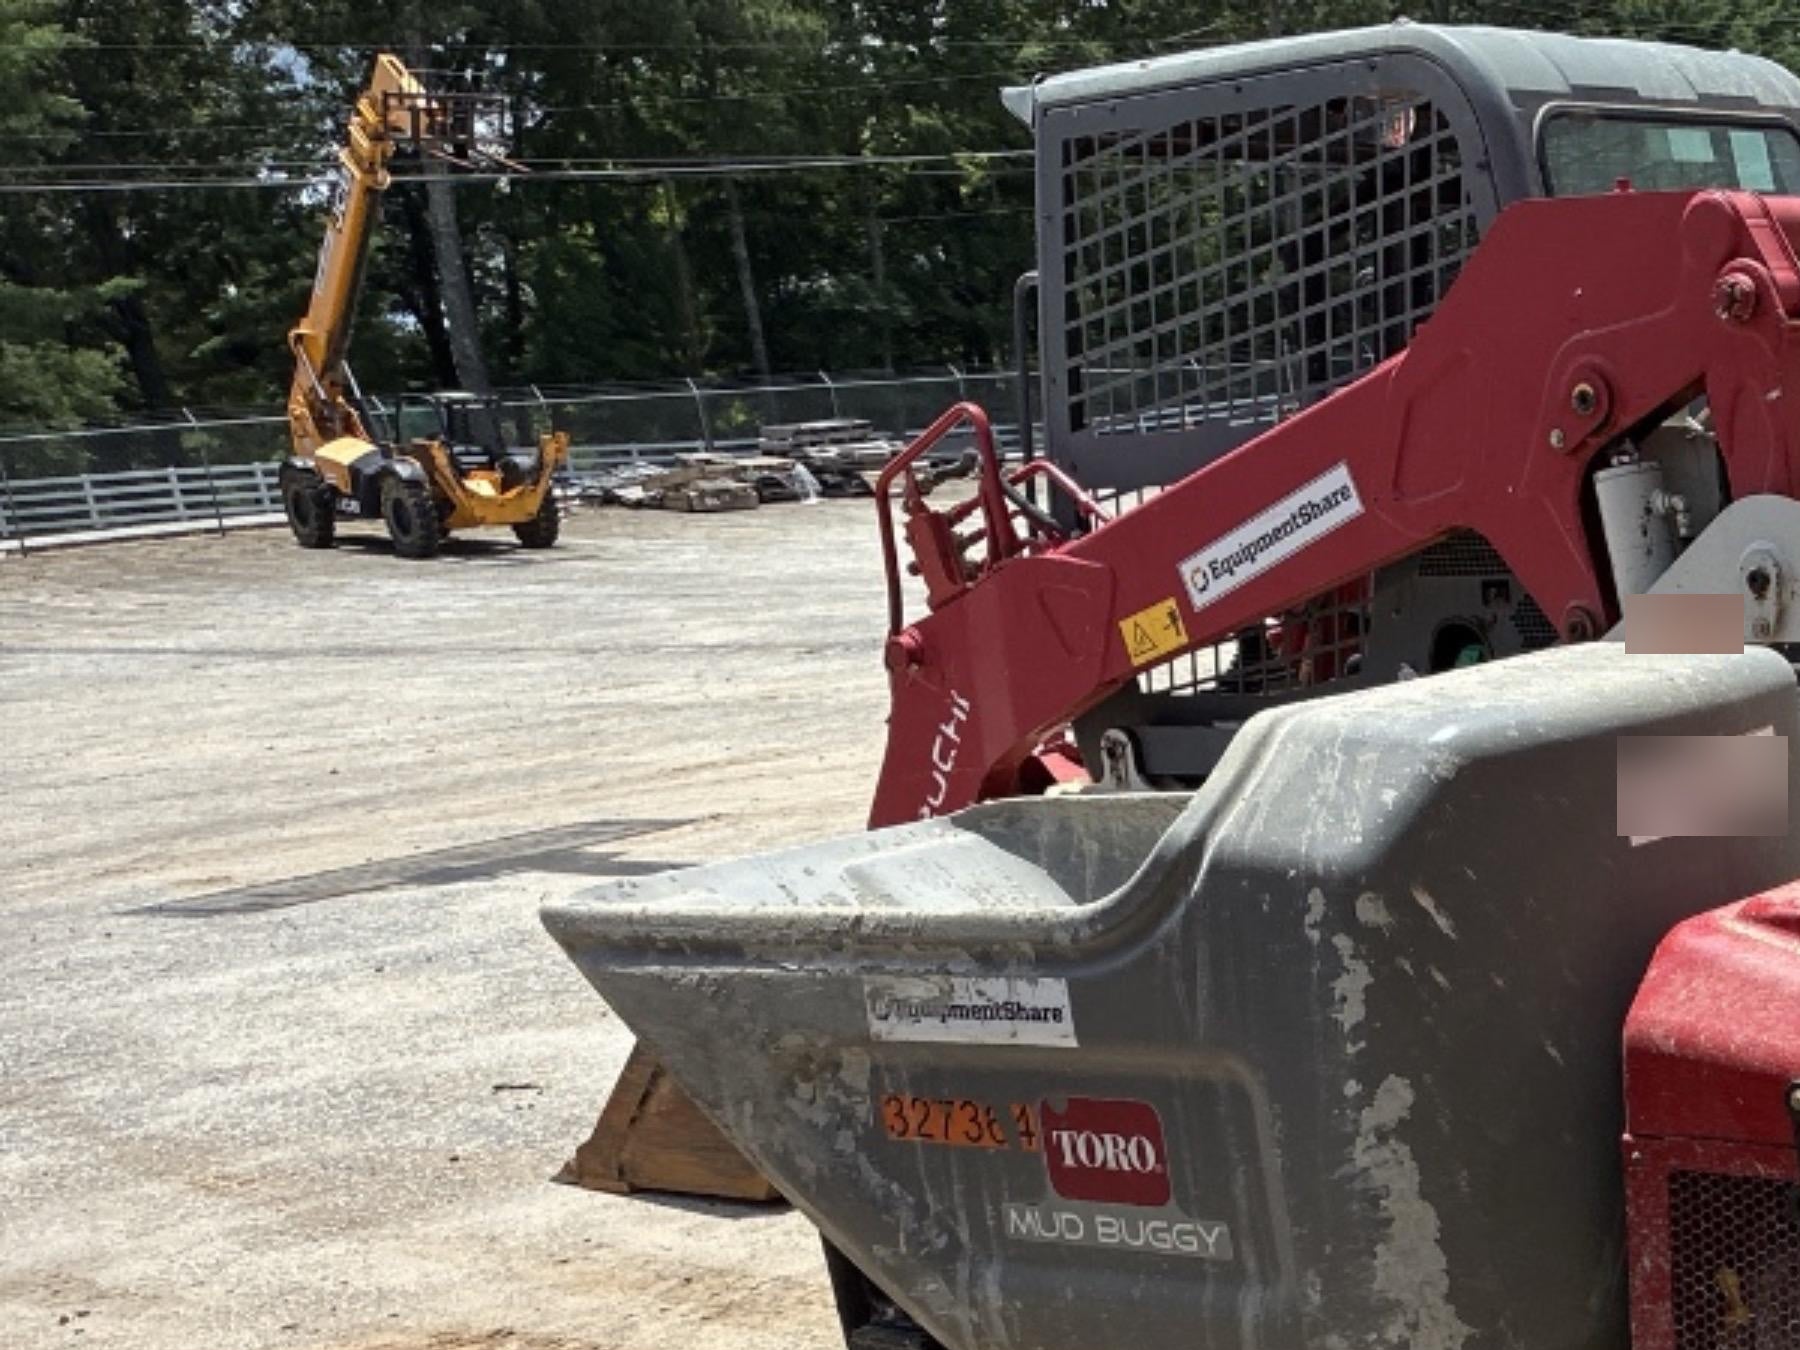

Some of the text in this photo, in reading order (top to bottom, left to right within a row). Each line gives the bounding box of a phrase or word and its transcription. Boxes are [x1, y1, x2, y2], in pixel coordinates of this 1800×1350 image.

[1208, 482, 1352, 581] EquipmentShare
[1052, 1130, 1156, 1173] TORO
[1009, 1208, 1222, 1253] MUD BUGGY
